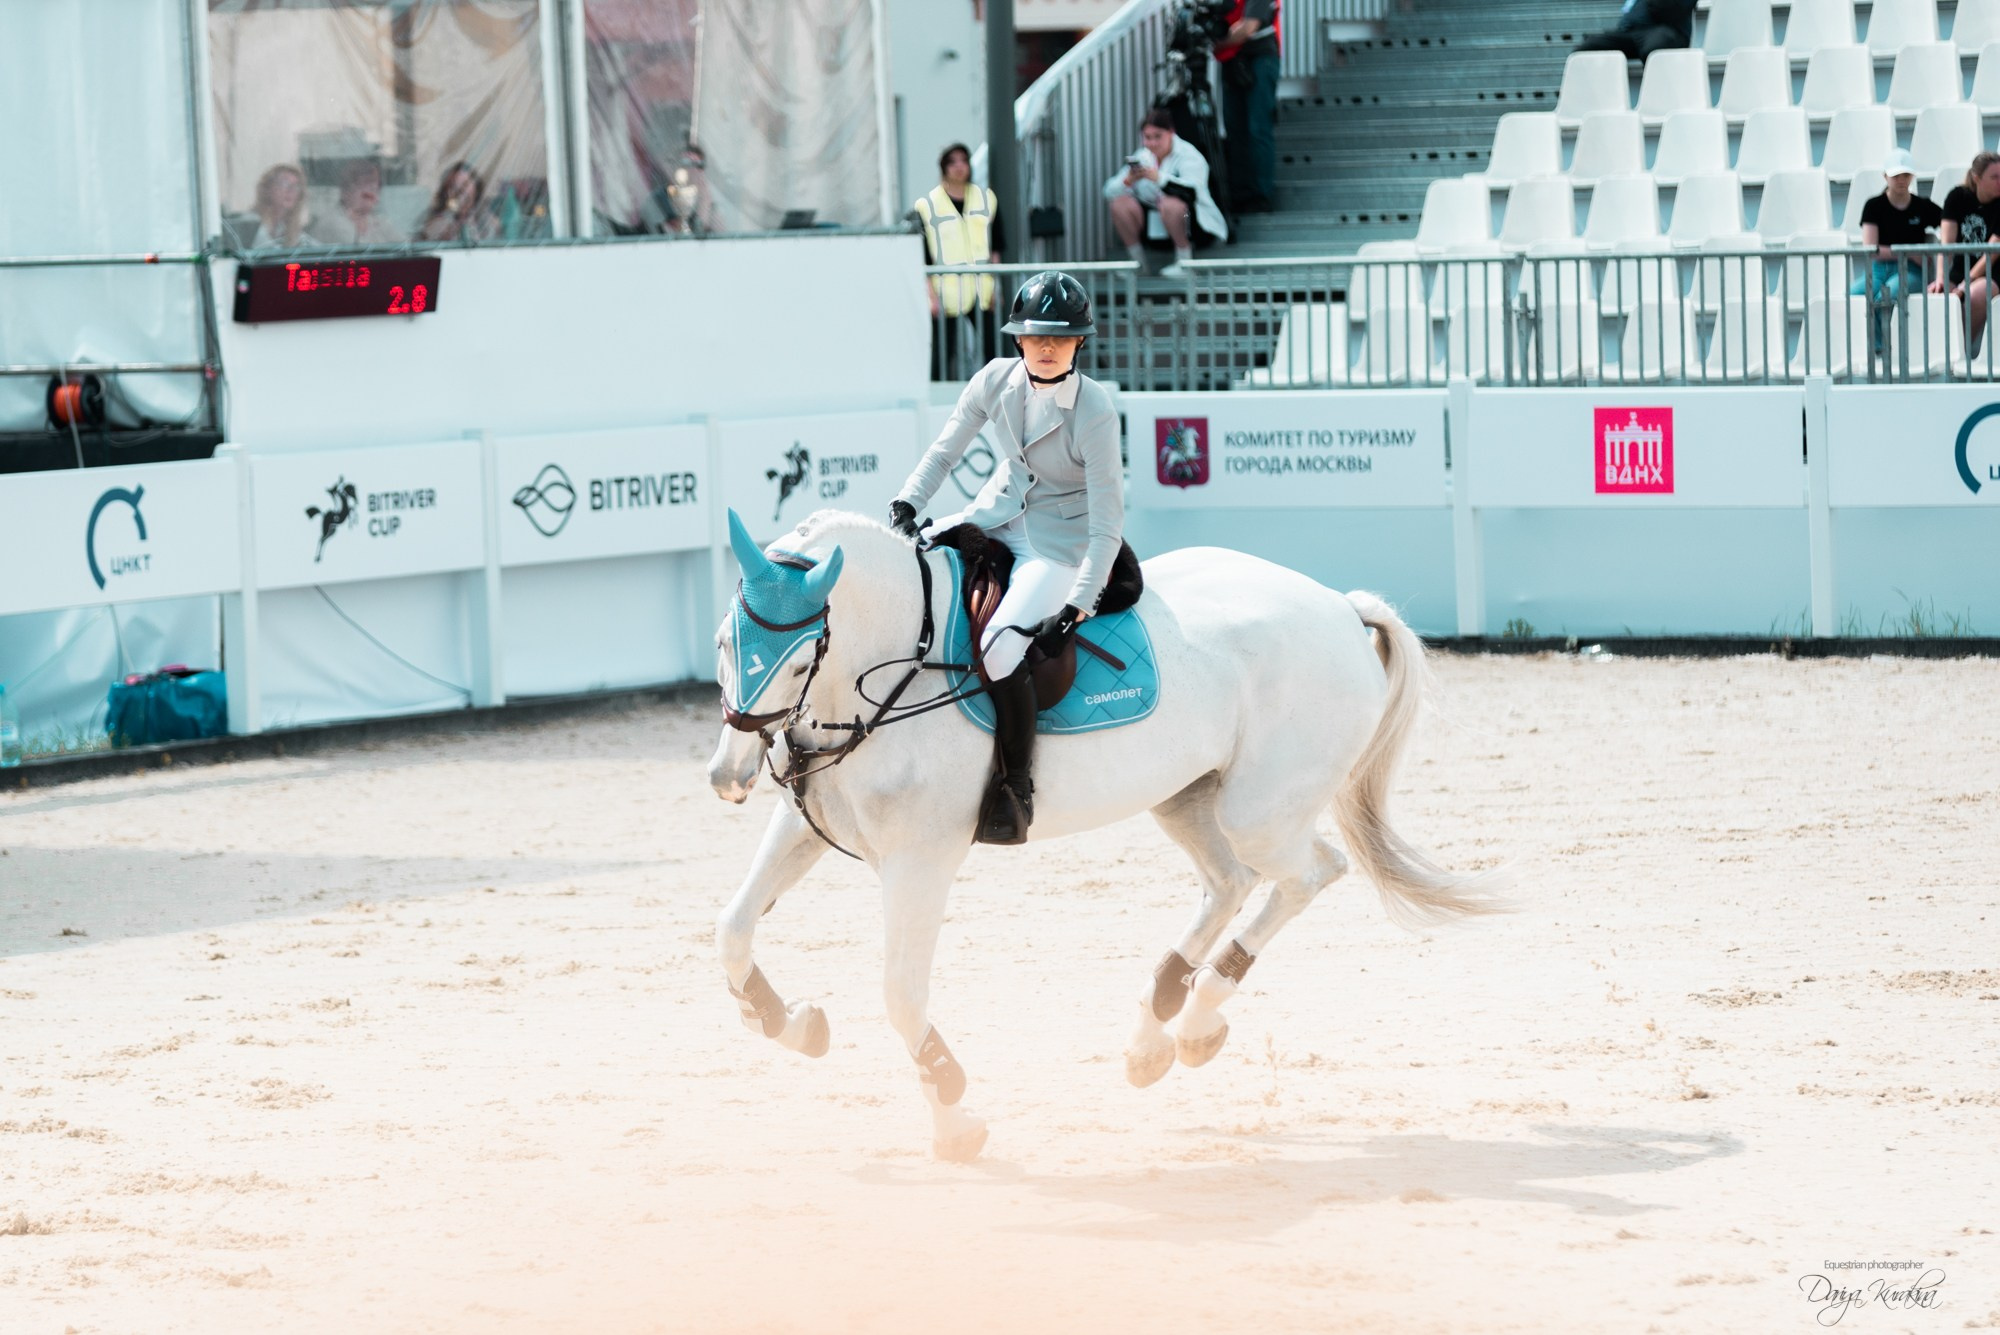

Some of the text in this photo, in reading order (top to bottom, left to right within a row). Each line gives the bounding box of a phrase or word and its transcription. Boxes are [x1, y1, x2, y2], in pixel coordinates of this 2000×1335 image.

[387, 284, 428, 314] 2.8
[1224, 428, 1416, 448] КОМИТЕТ ПО ТУРИЗМУ
[819, 454, 878, 475] BITRIVER
[1225, 454, 1372, 475] ГОРОДА МОСКВЫ
[1605, 464, 1664, 485] ВДНХ
[368, 488, 436, 512] BITRIVER
[590, 472, 698, 511] BITRIVER
[819, 480, 848, 499] CUP
[368, 515, 401, 536] CUP
[1085, 687, 1143, 705] самолет
